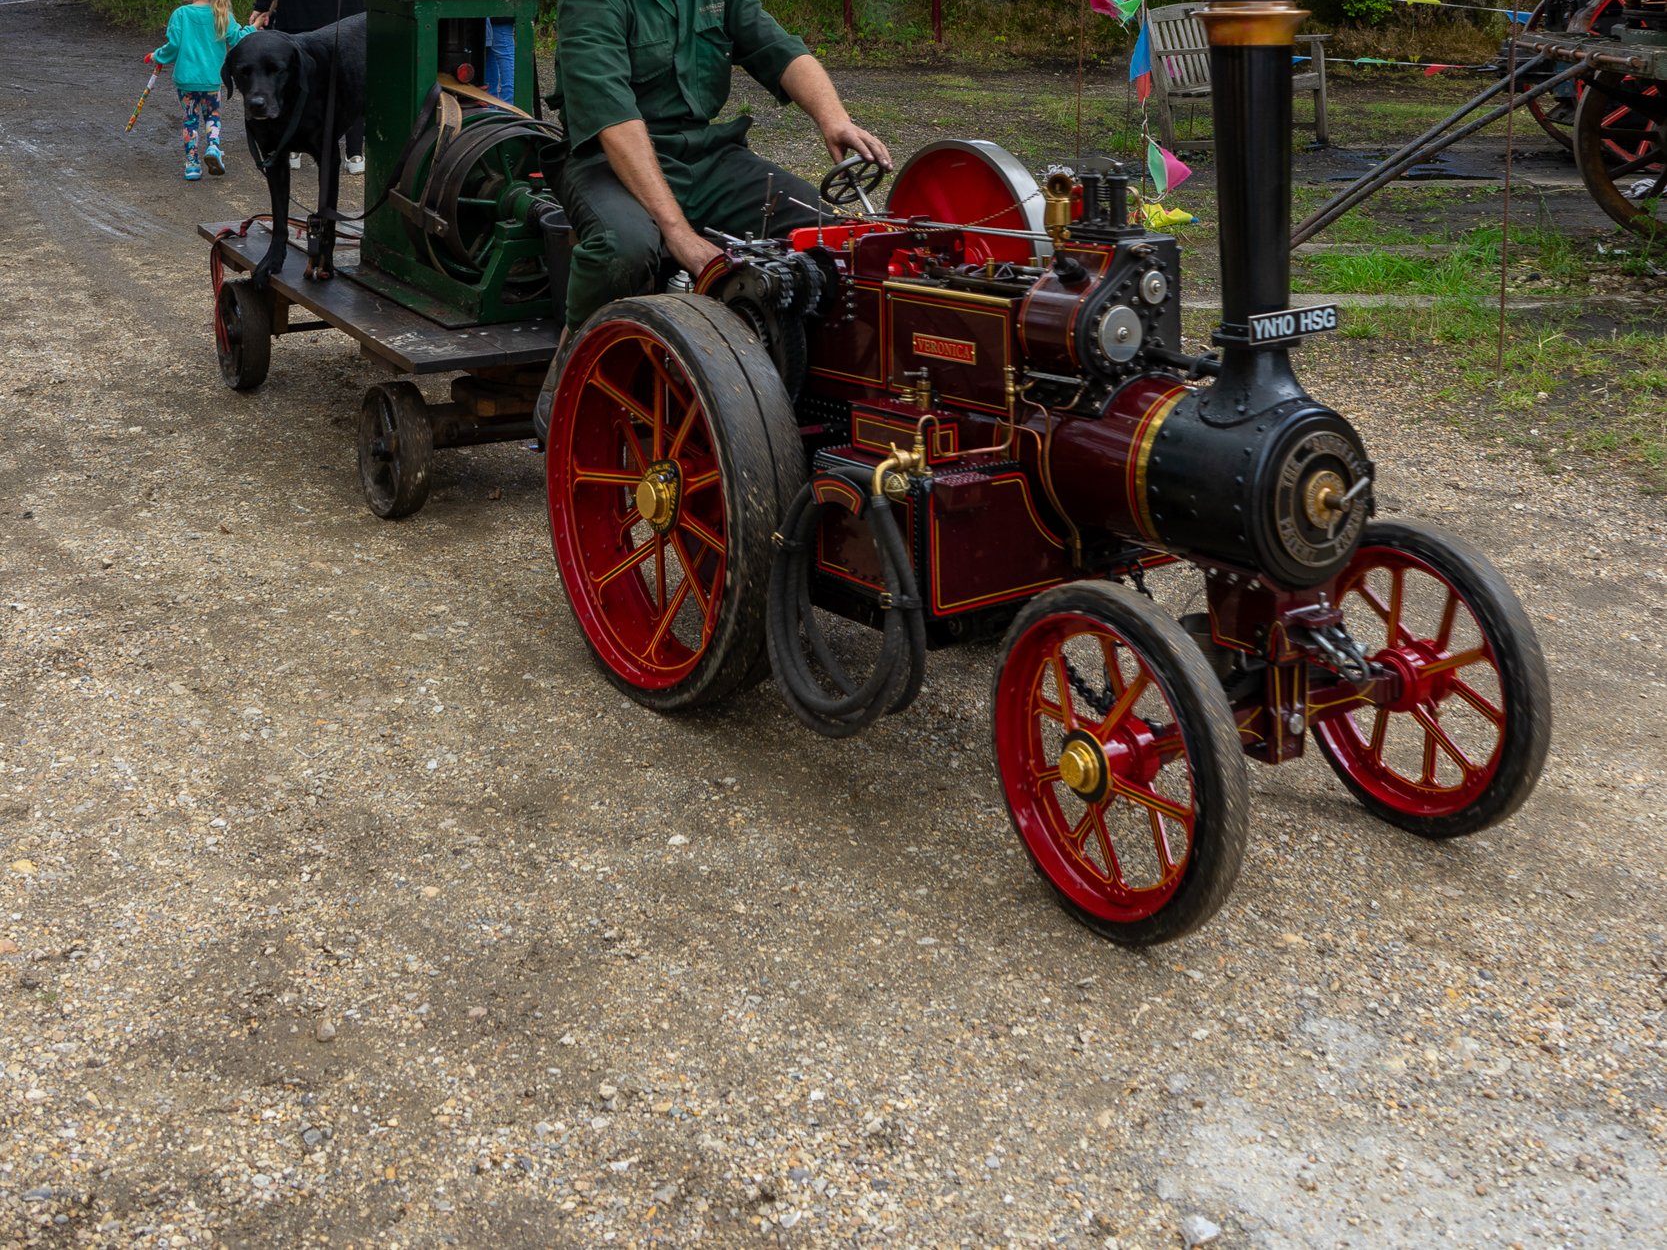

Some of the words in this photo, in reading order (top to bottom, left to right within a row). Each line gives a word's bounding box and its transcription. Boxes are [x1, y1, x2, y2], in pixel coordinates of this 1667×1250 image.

[1253, 314, 1295, 340] YN10
[1300, 307, 1336, 332] HSG
[917, 337, 971, 359] VERONICA
